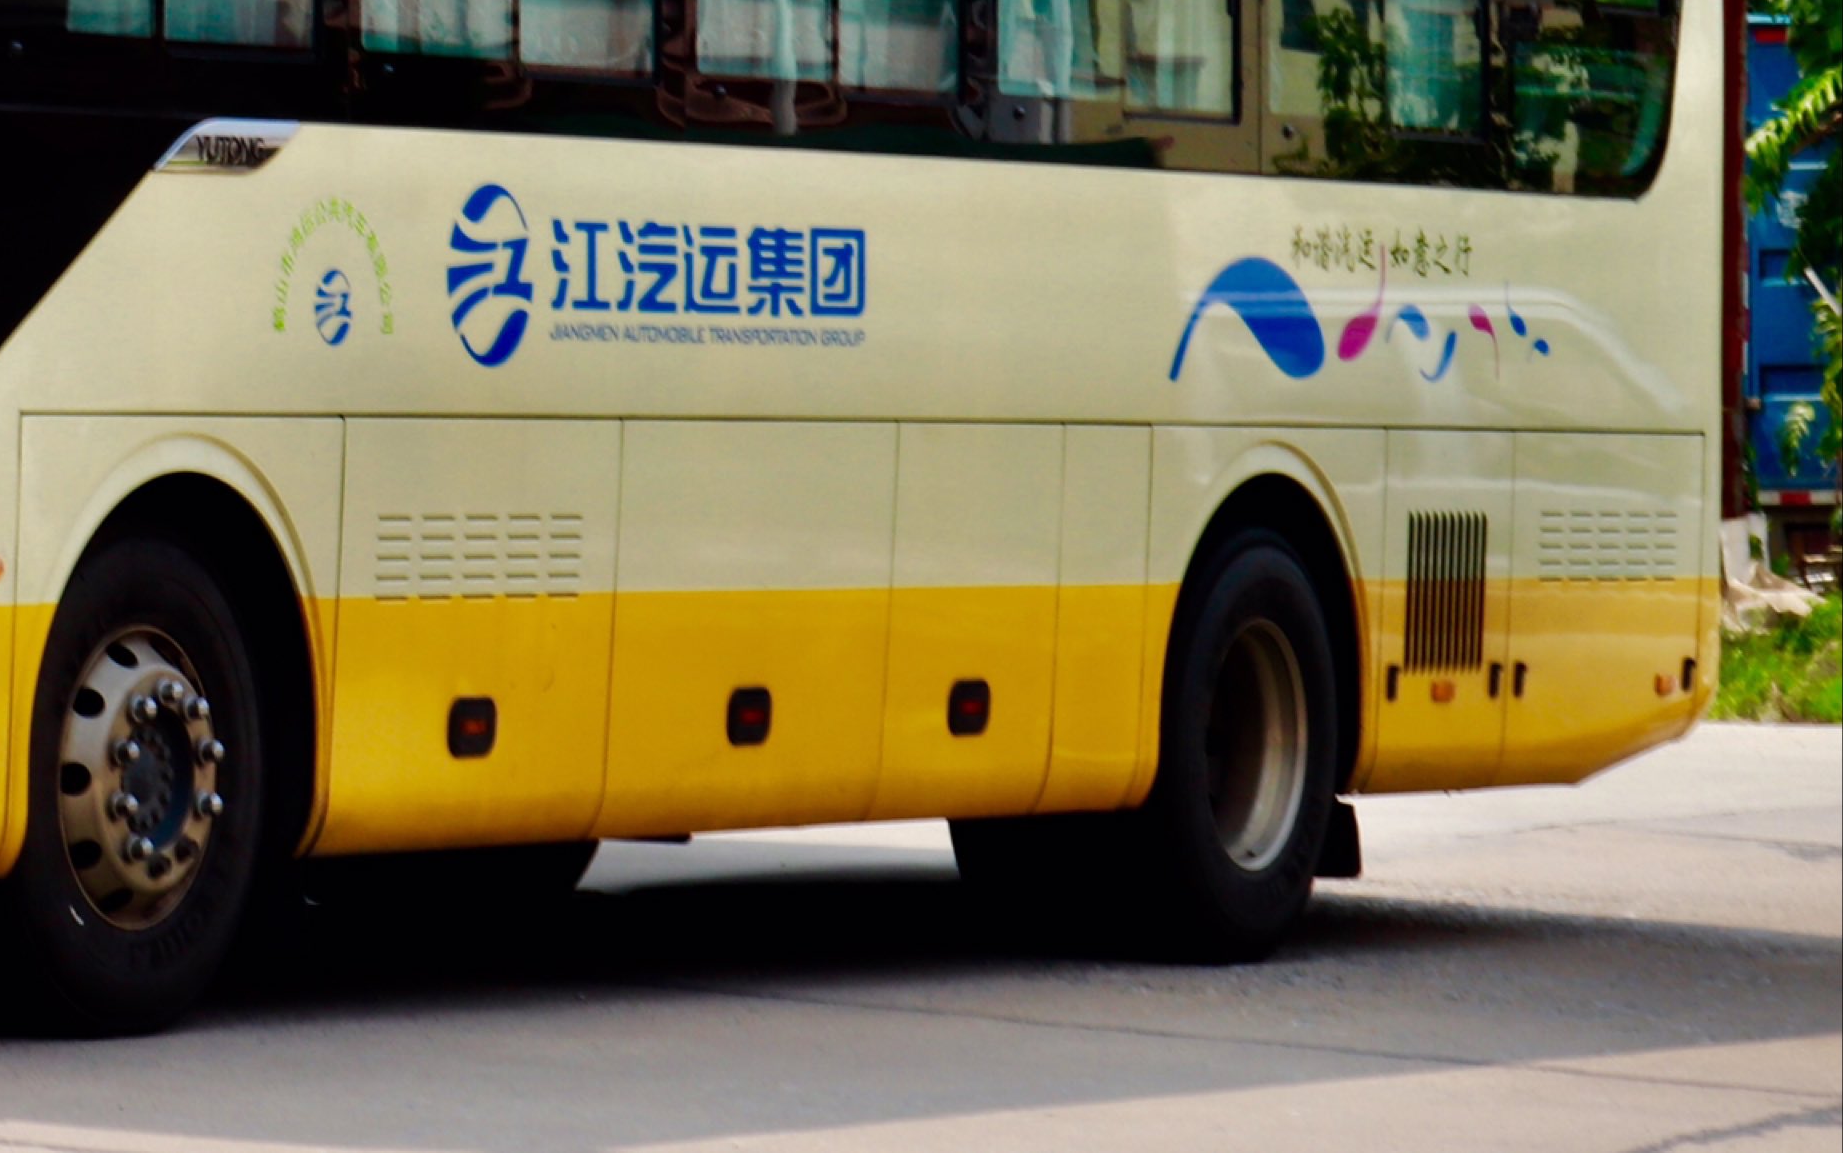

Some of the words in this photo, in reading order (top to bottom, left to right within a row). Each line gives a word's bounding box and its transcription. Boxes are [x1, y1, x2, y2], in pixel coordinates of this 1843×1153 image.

[197, 135, 265, 168] YUTONG
[551, 219, 866, 317] 江汽运集团
[550, 323, 618, 342] JIANGMEN
[623, 324, 706, 344] AUTOMOBILE
[710, 326, 817, 346] TRANSPORTATION
[820, 328, 866, 347] GROUP
